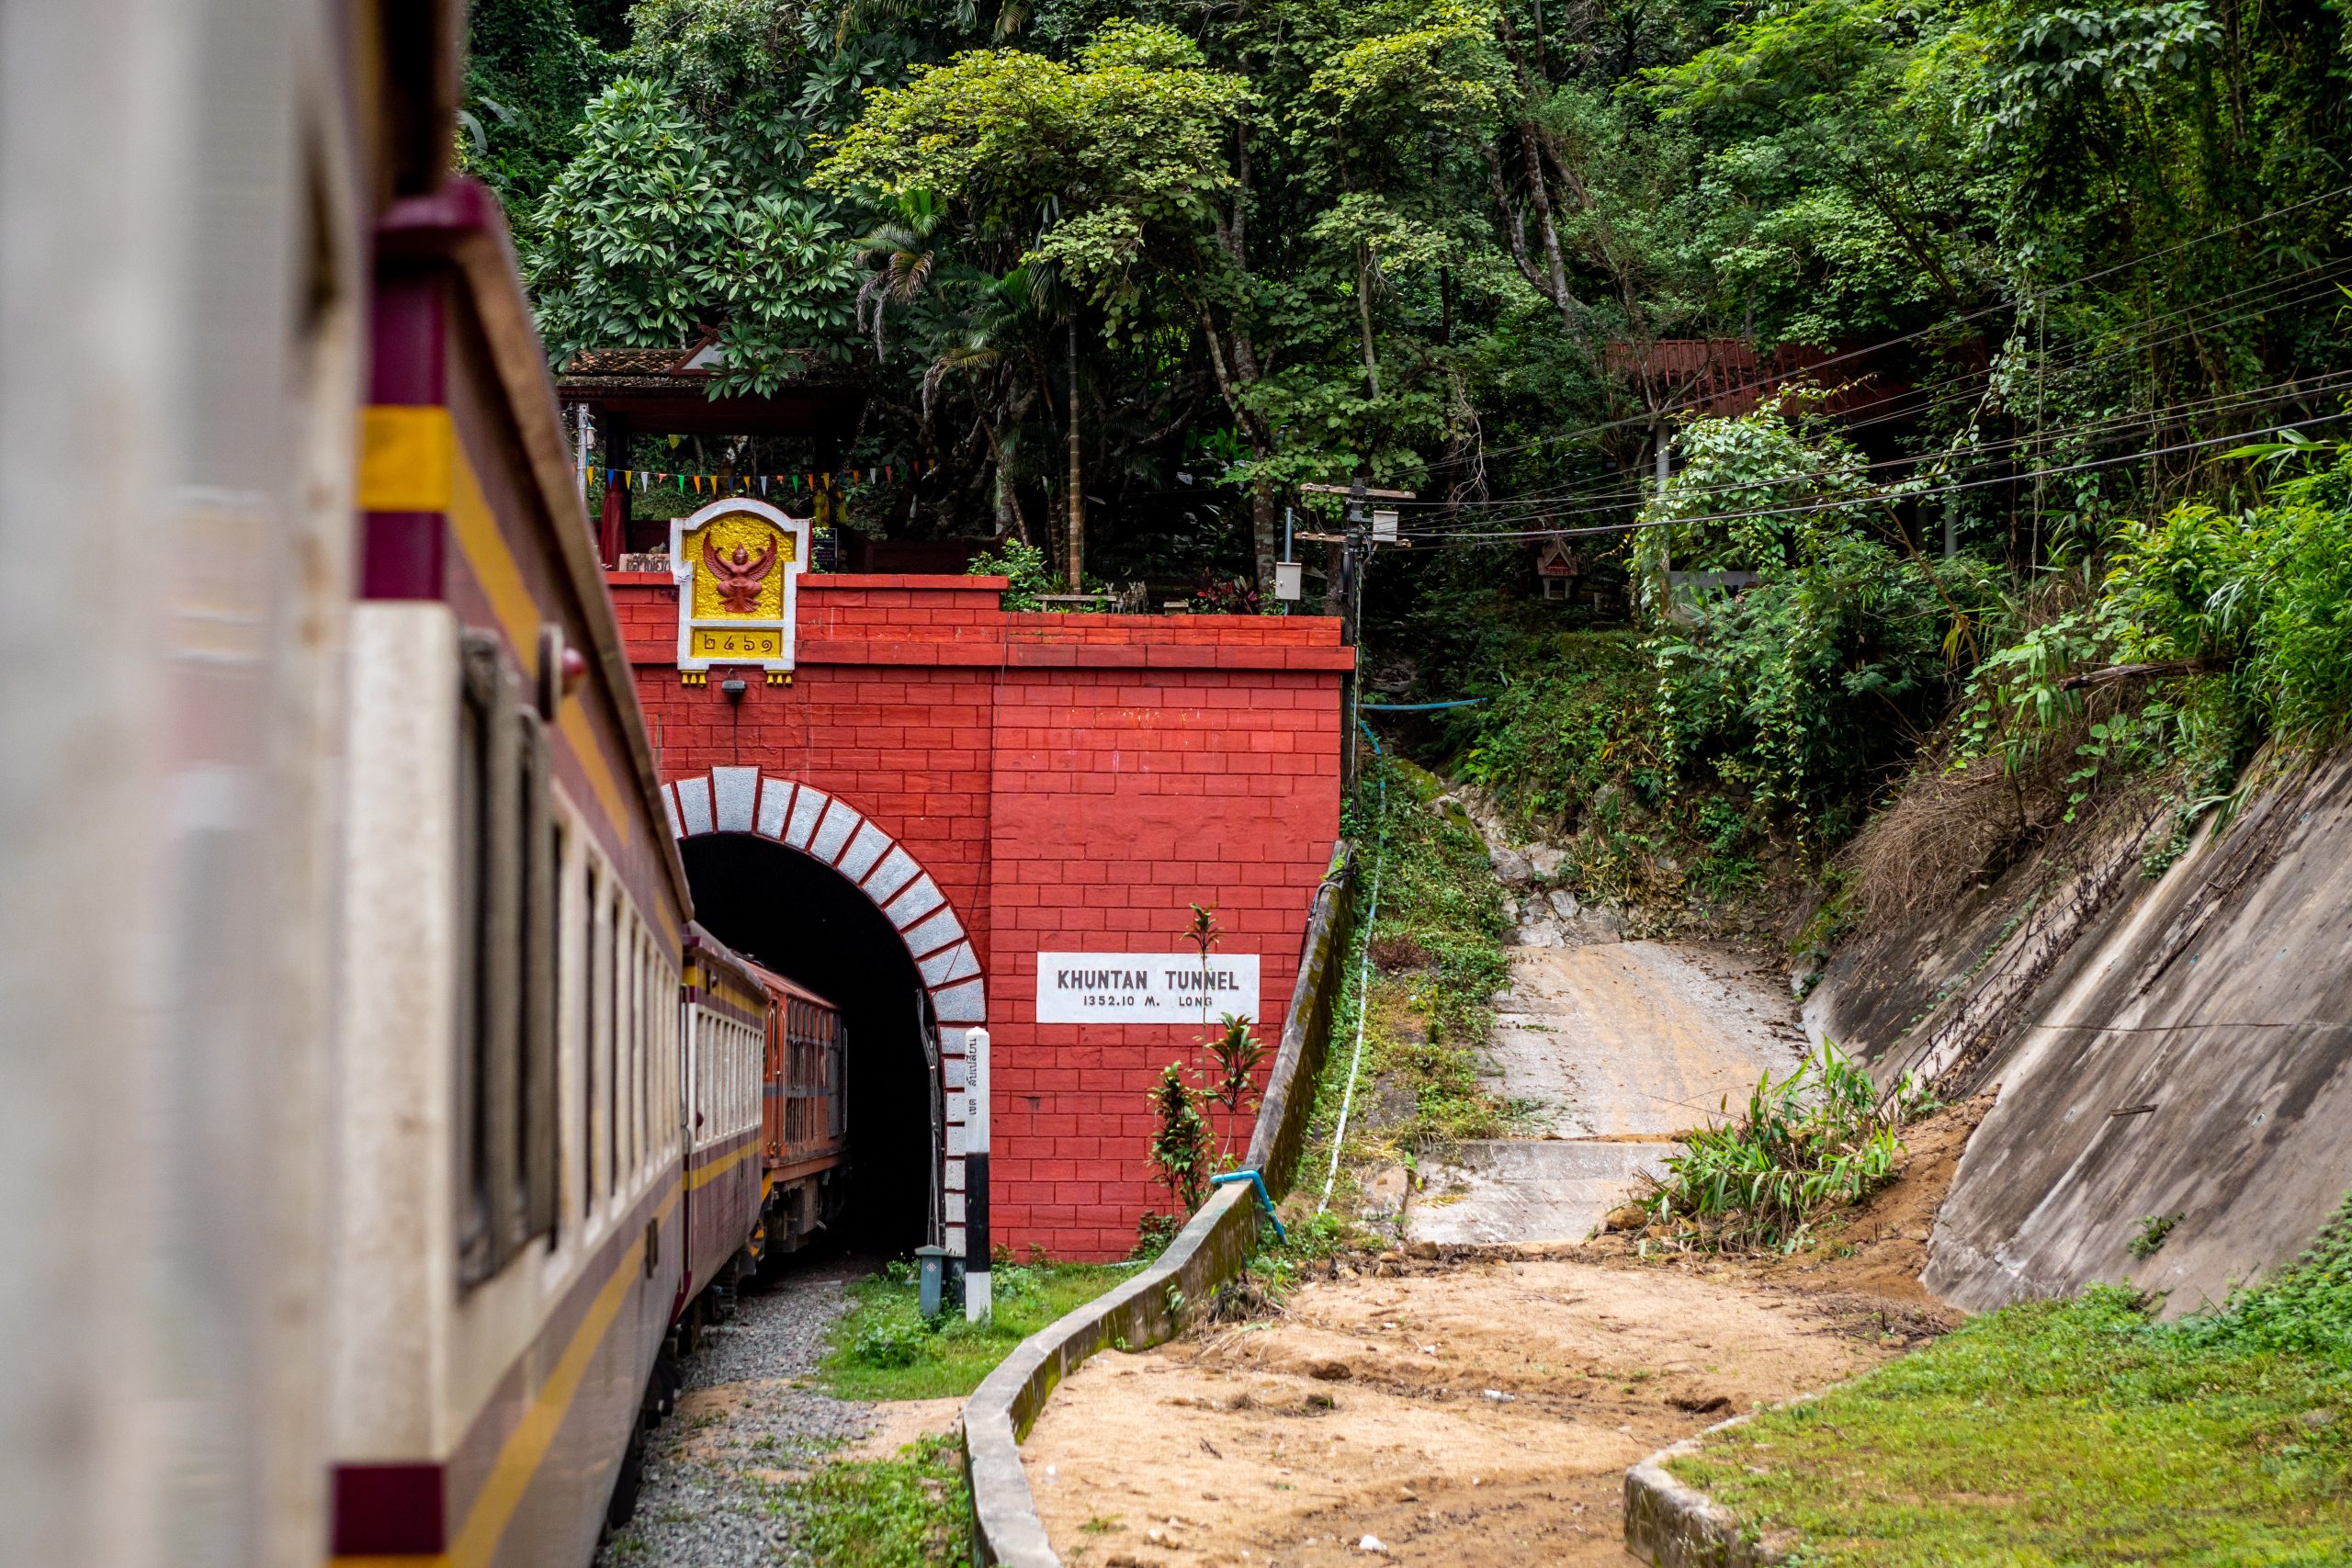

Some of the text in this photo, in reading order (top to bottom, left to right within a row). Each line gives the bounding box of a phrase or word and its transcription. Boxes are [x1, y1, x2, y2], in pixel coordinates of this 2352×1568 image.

[705, 634, 773, 653] ๒๔๖๑
[1057, 970, 1239, 990] KHUNTAN TUNNEL
[1083, 995, 1213, 1007] 1352.10 M. LONG
